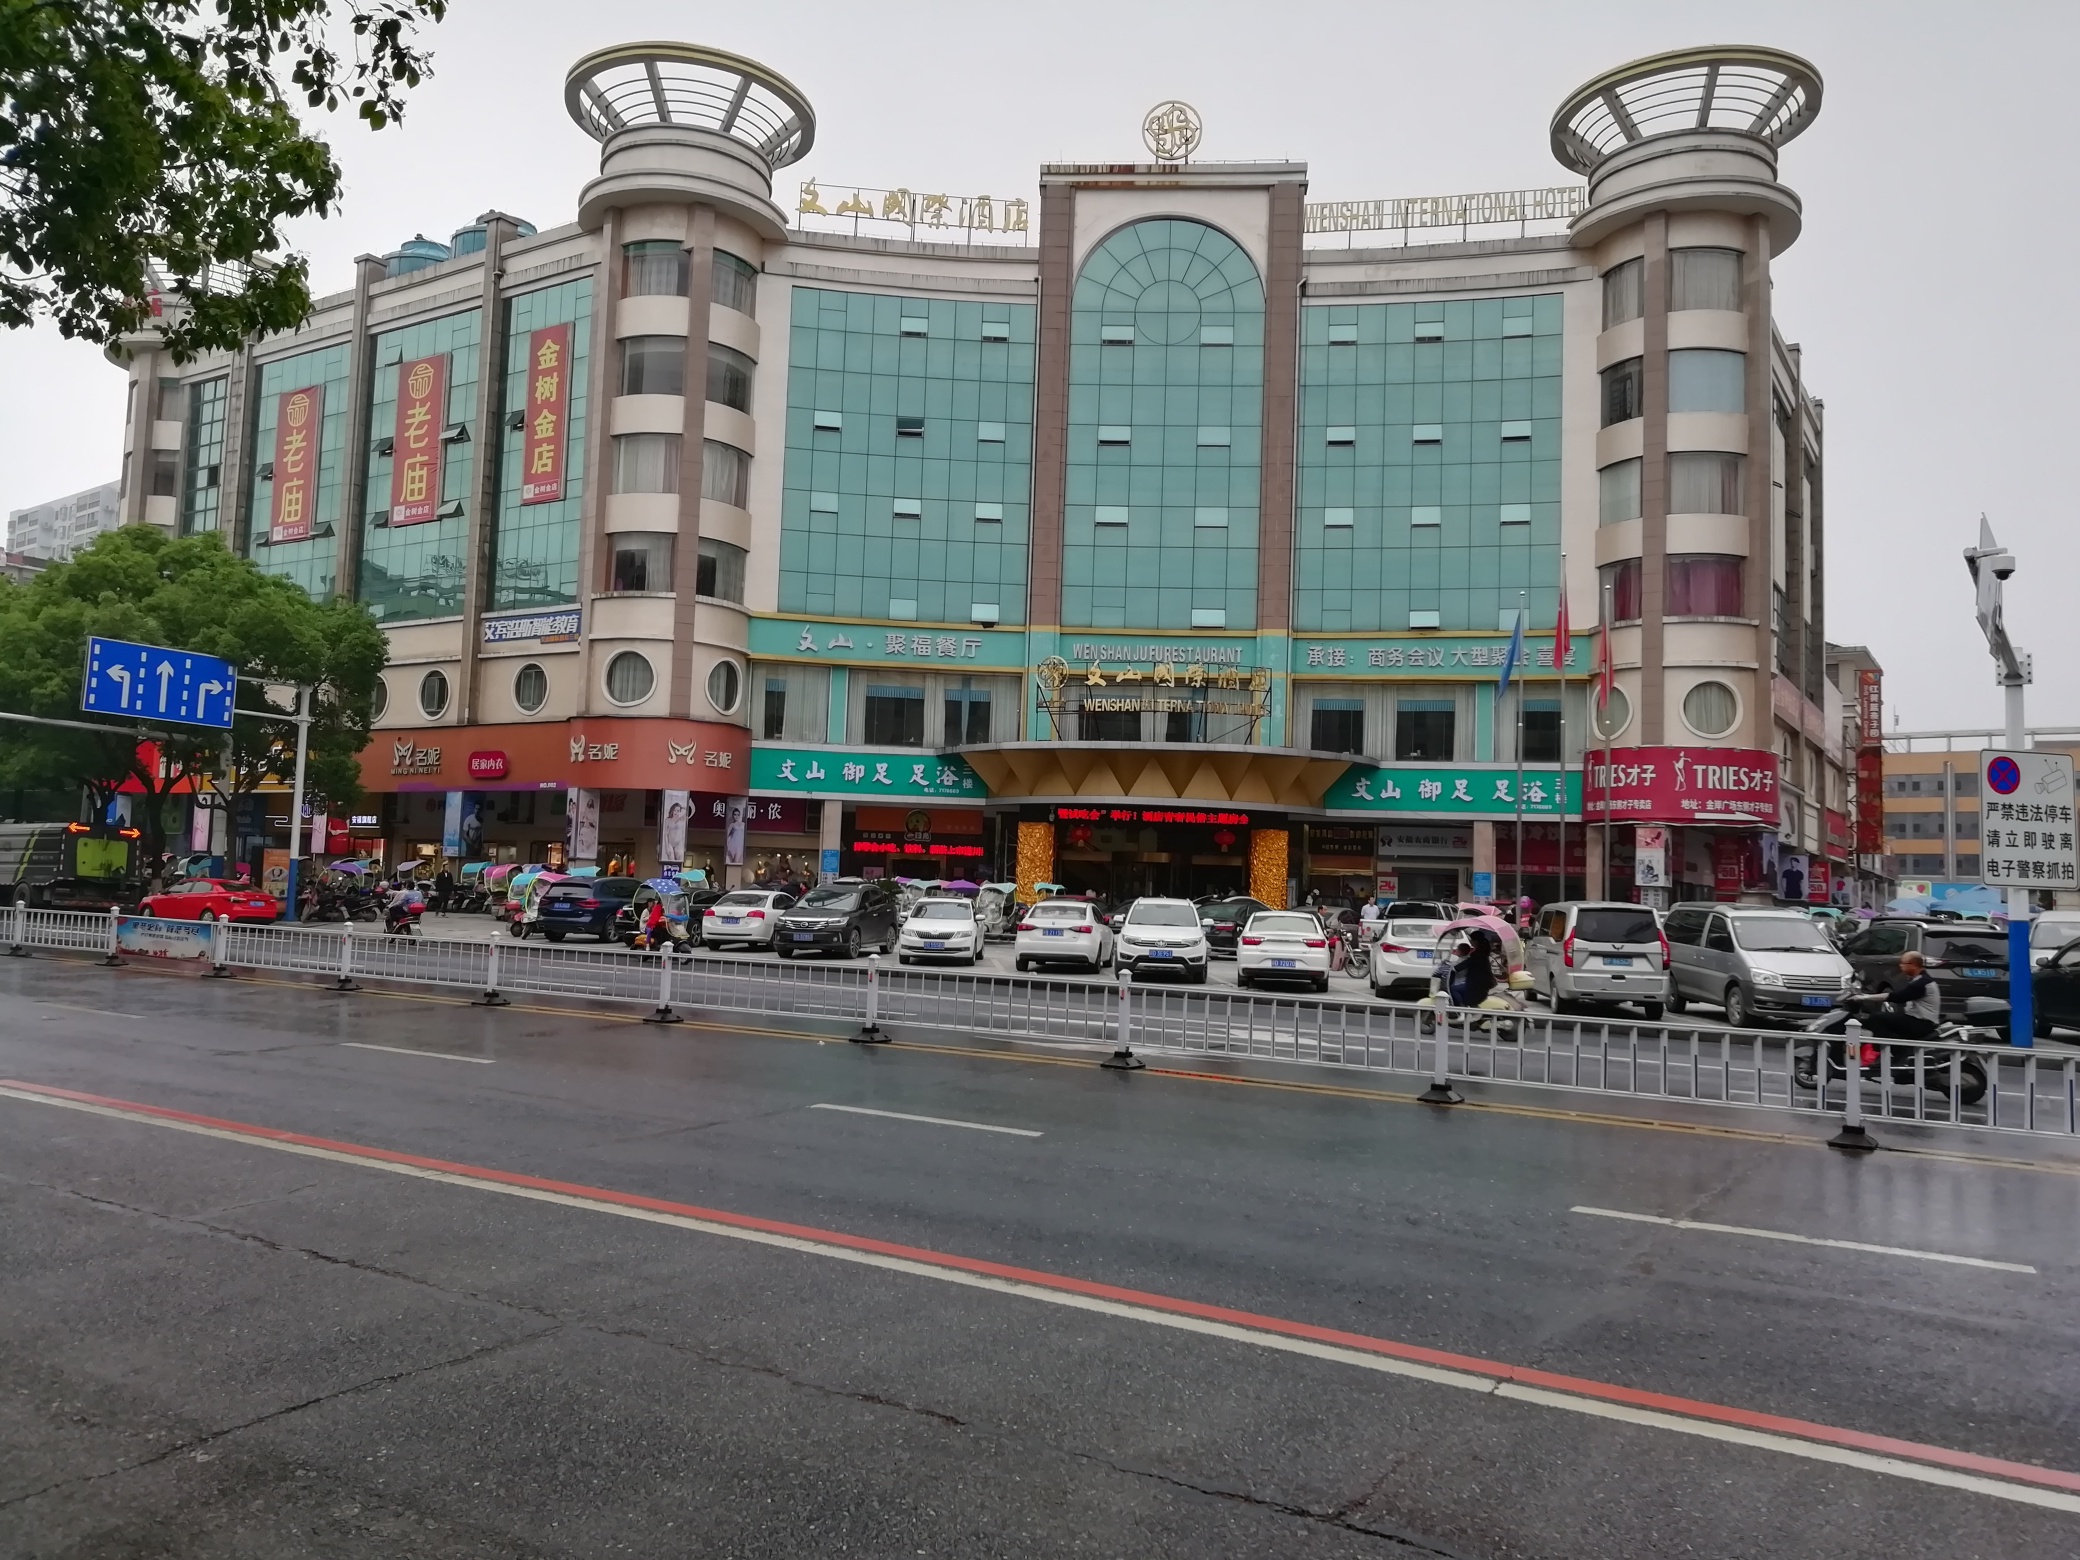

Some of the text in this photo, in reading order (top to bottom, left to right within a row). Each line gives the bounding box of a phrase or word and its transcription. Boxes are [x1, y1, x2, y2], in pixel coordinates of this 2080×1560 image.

[1305, 201, 1384, 232] WENSHAN
[1391, 190, 1527, 228] INTERNATIONAL
[531, 338, 561, 474] 金树金店
[400, 401, 432, 503] 老庙
[278, 428, 307, 524] 老庙
[534, 482, 558, 495] 金树金店
[1084, 698, 1140, 712] WENSHAN
[415, 747, 441, 766] 名妮
[588, 743, 619, 760] 名妮
[703, 750, 732, 769] 名妮
[471, 758, 504, 770] 居家内衣
[1986, 801, 2072, 824] 严禁违法停车
[1986, 829, 2073, 851] 请立即驶离
[1987, 858, 2075, 881] 电子警察抓拍
[1379, 880, 1397, 892] 24
